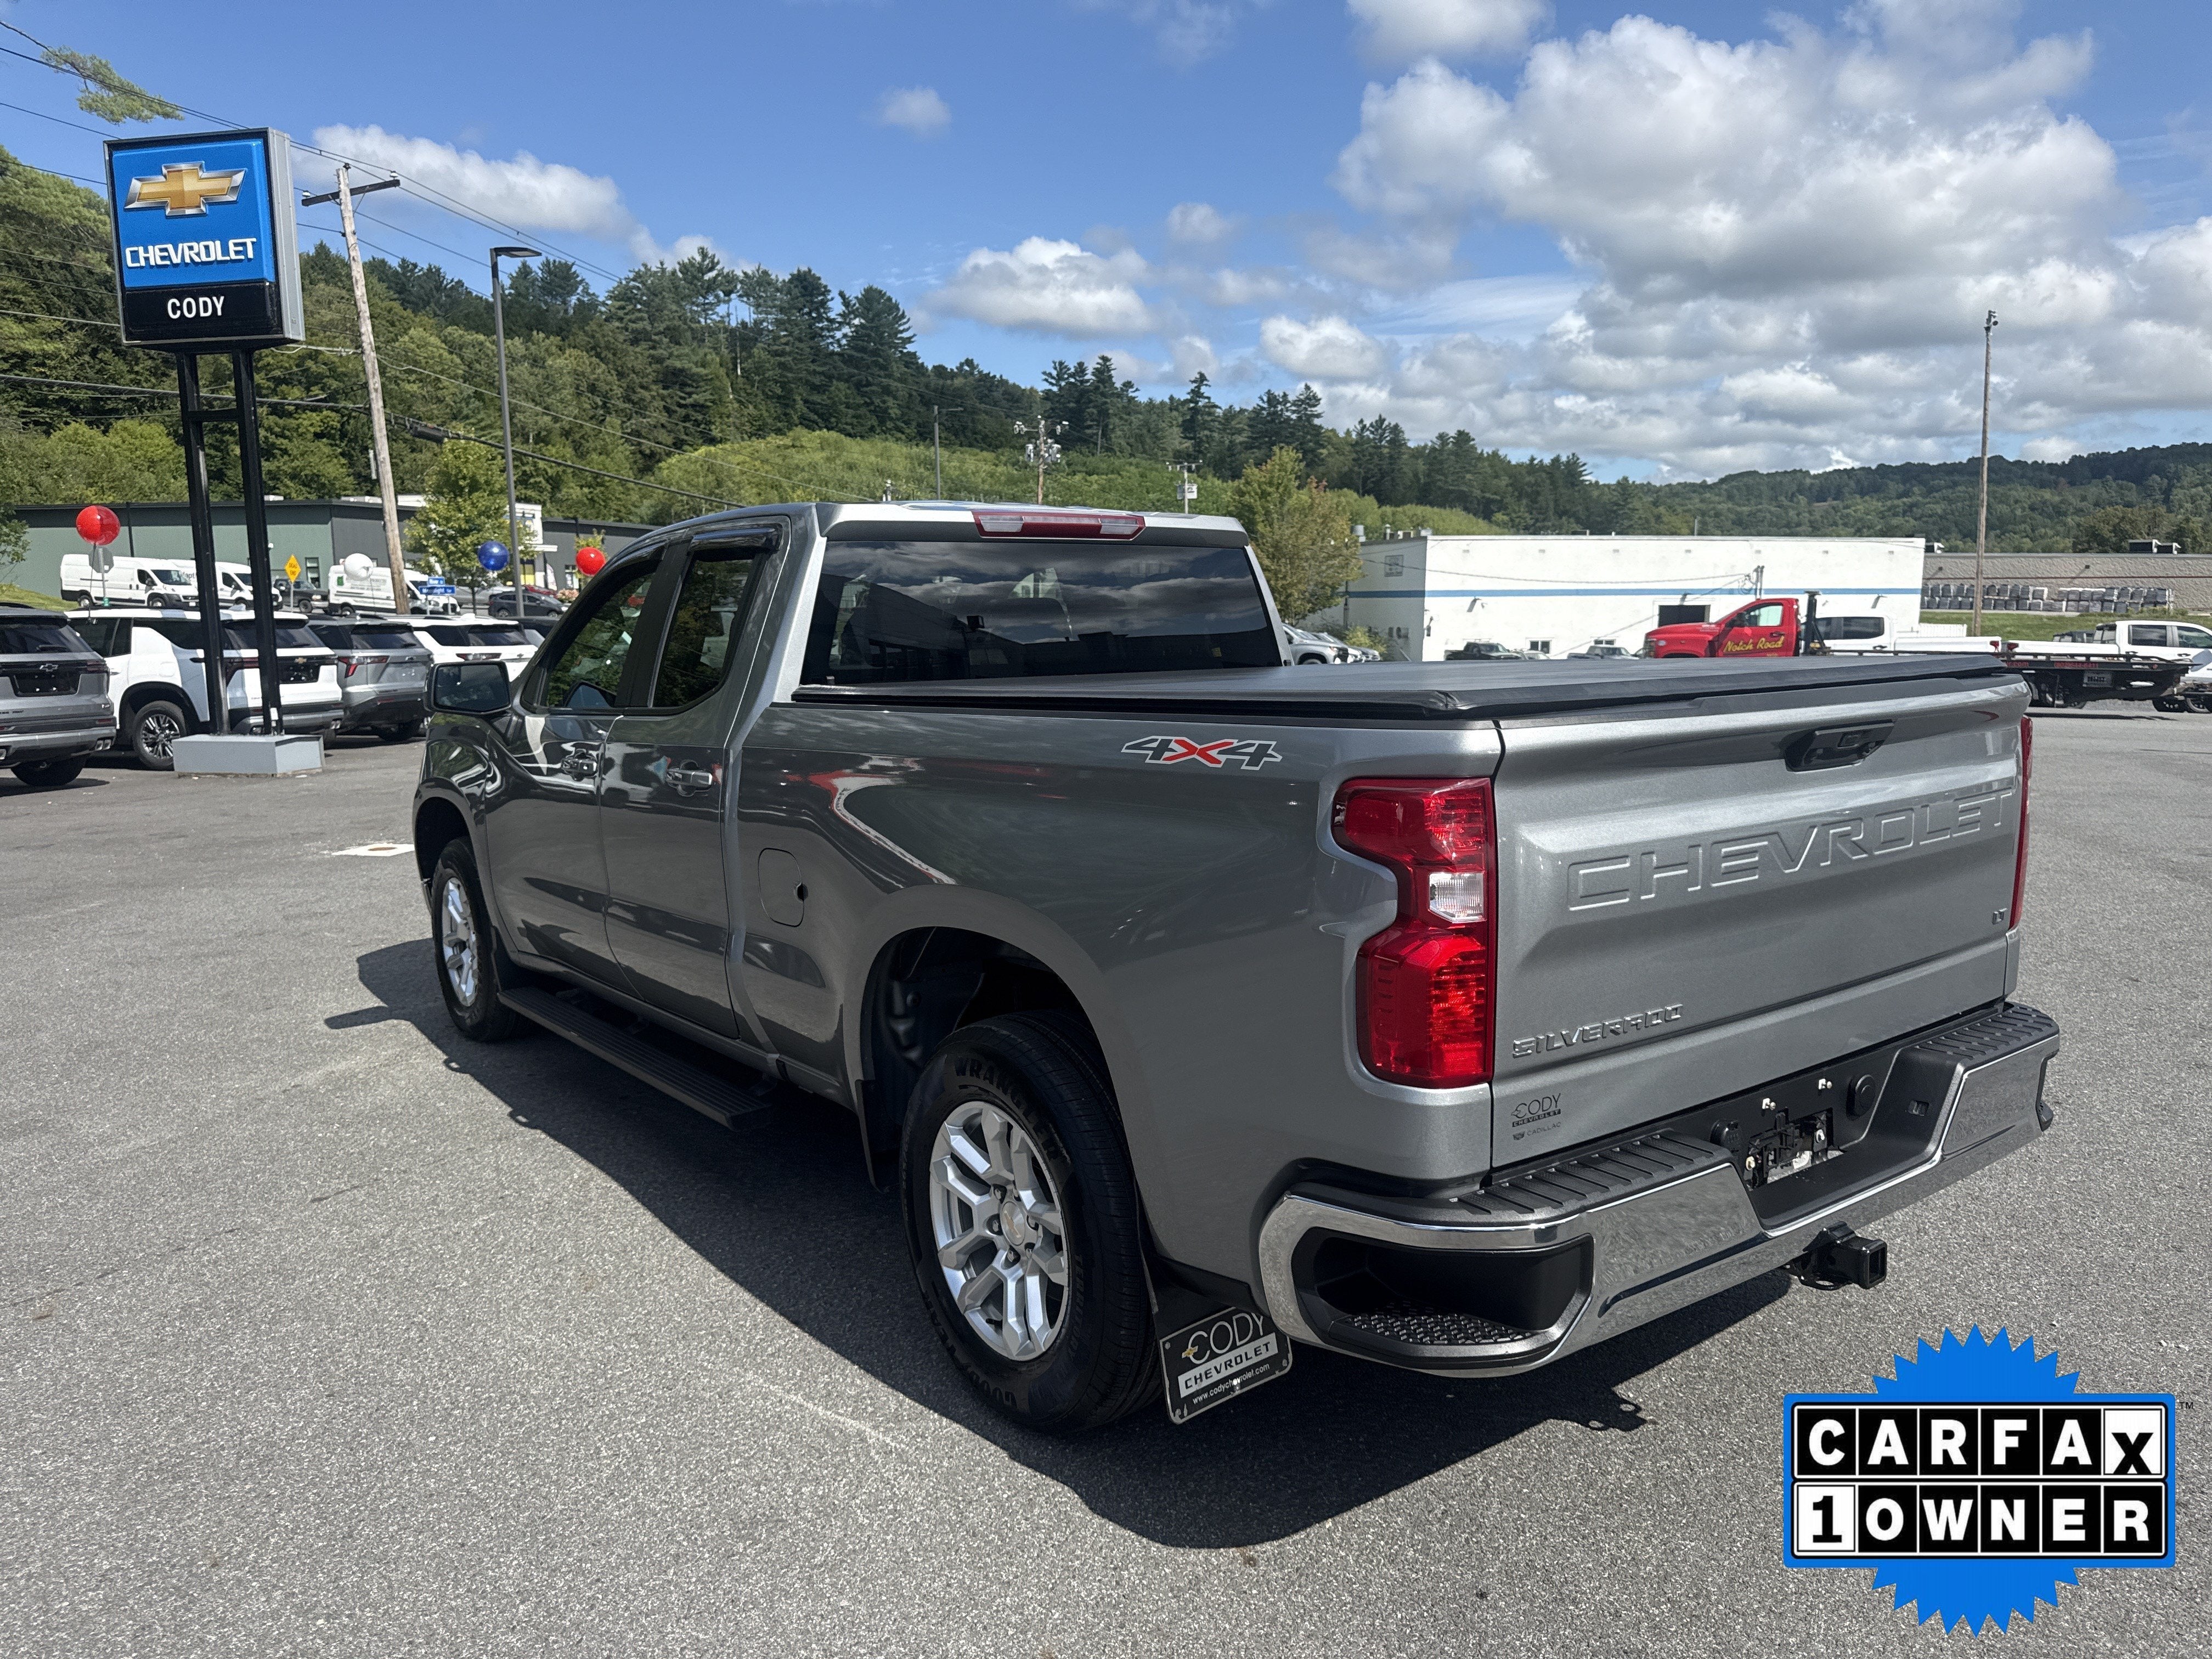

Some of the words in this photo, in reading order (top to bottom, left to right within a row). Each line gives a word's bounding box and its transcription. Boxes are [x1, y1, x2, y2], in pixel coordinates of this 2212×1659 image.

[126, 238, 257, 268] CHEVROLET
[167, 296, 225, 319] CODY
[1723, 639, 1753, 652] Notch
[1756, 635, 1785, 650] Road
[1568, 787, 2013, 911] CHEVROLET
[1992, 907, 2007, 925] LT
[1513, 1004, 1683, 1059] SILVERADO
[1513, 1093, 1561, 1119] CODY
[1513, 1109, 1561, 1127] CHEVROLET
[1527, 1121, 1561, 1136] CADILLAC
[1187, 1312, 1263, 1364] CODY
[1185, 1341, 1271, 1390] CHEVROLET
[1193, 1363, 1270, 1404] www.codychevrolet.com
